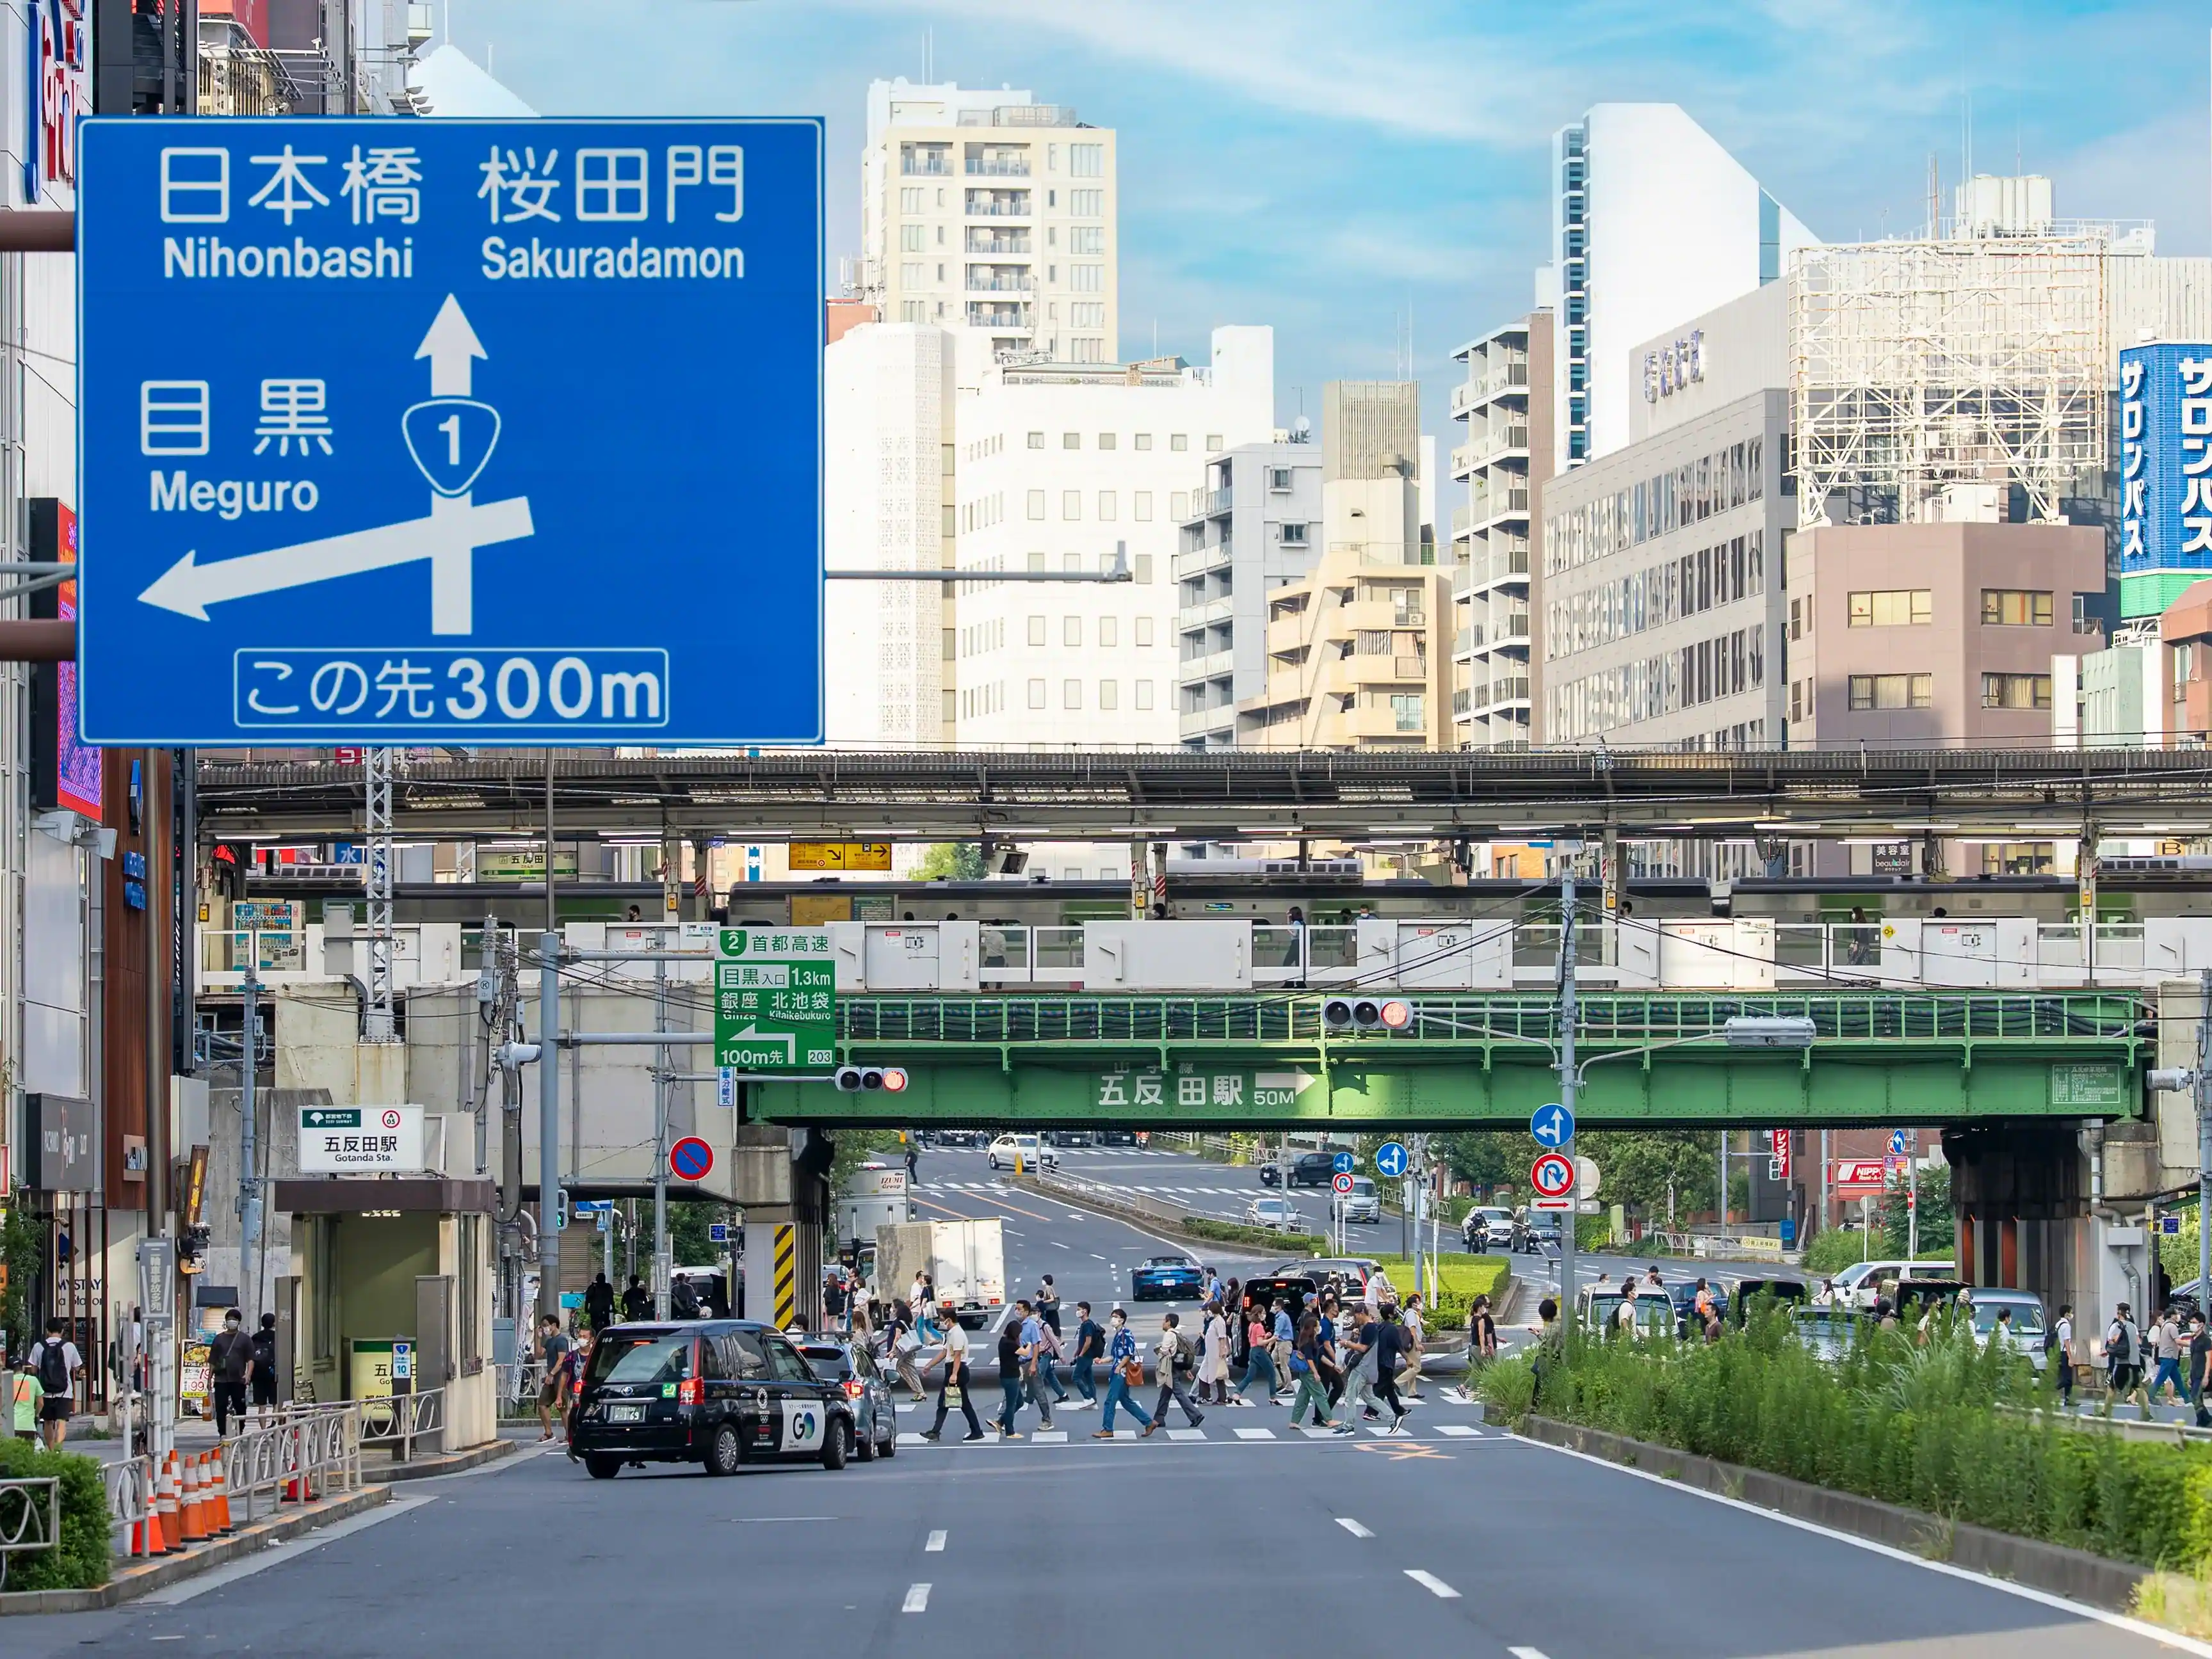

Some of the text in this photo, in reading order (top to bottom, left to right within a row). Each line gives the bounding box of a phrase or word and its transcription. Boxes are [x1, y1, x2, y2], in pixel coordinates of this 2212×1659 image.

[160, 143, 745, 225] 日本橋 桜田門
[163, 236, 745, 280] Nihonbashi Sakuradamon
[140, 378, 334, 456] 目黒
[438, 414, 460, 465] 1
[2121, 361, 2145, 557] サロンパス
[149, 470, 319, 520] Meguro
[340, 847, 358, 863] 水
[1876, 844, 1910, 856] 美容室
[2161, 842, 2182, 855] B
[728, 935, 739, 950] 2
[752, 934, 829, 952] 首都高速
[791, 967, 830, 986] 1.3km
[721, 992, 829, 1009] 銀座 北池袋
[723, 1010, 831, 1020] Ginza Kitaikebukuro
[720, 1050, 783, 1064] 100m先
[809, 1051, 831, 1063] 203
[1098, 1075, 1243, 1106] 五反田駅
[1254, 1091, 1295, 1106] 50M
[324, 1136, 397, 1153] 五反田駅
[335, 1153, 393, 1162] Gotanda Sta.
[397, 1365, 407, 1374] 10
